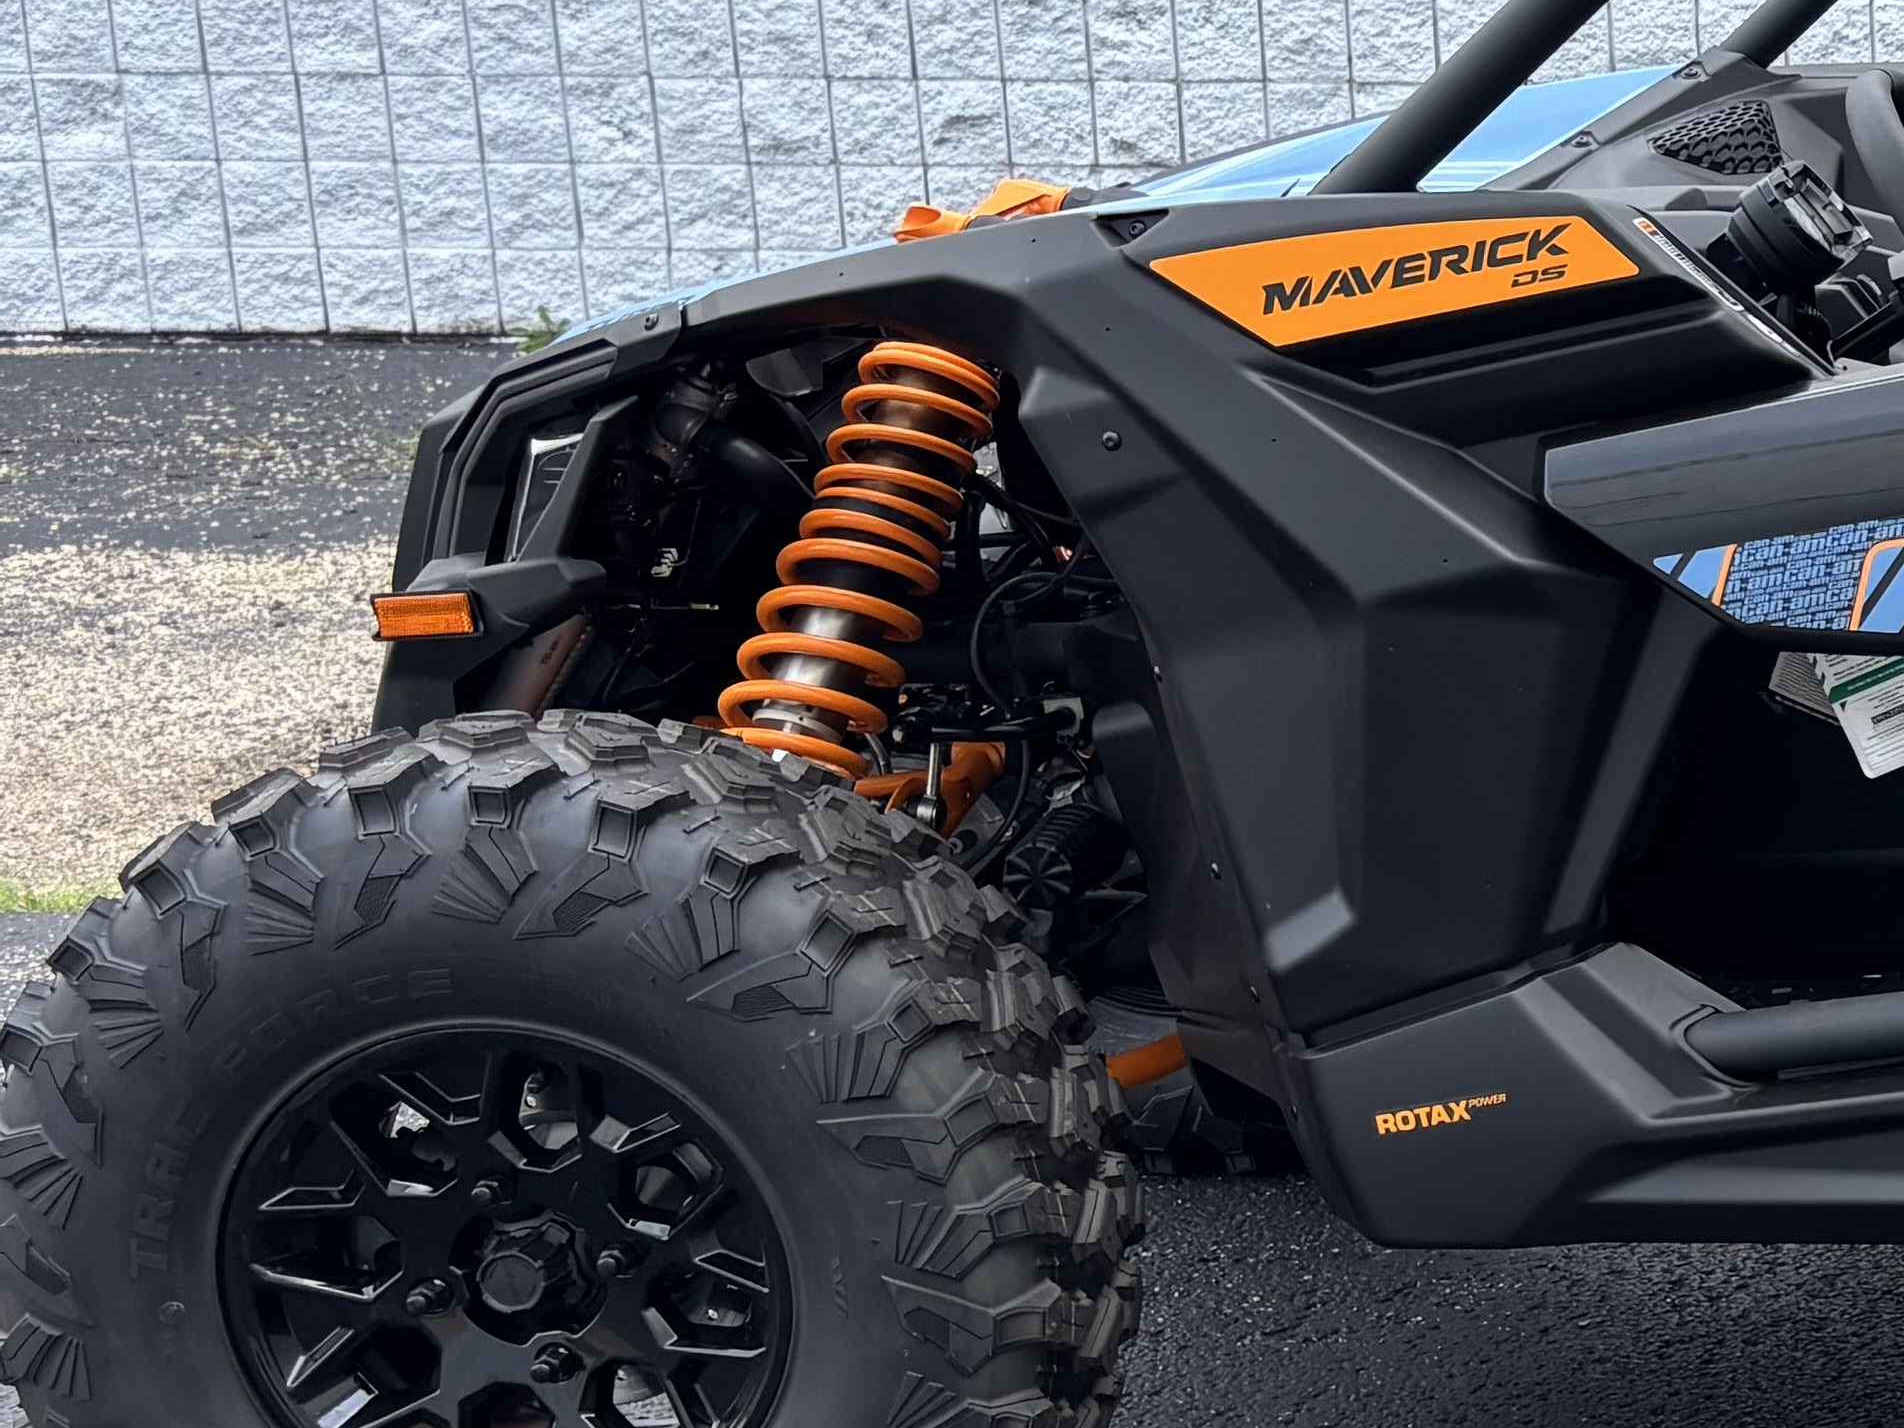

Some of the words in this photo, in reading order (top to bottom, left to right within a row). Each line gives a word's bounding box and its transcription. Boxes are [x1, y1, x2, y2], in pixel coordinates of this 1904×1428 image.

[1261, 223, 1572, 315] MAVERICK
[1510, 264, 1568, 289] DS
[1375, 1100, 1471, 1135] ROTAX
[1468, 1092, 1507, 1108] POWER
